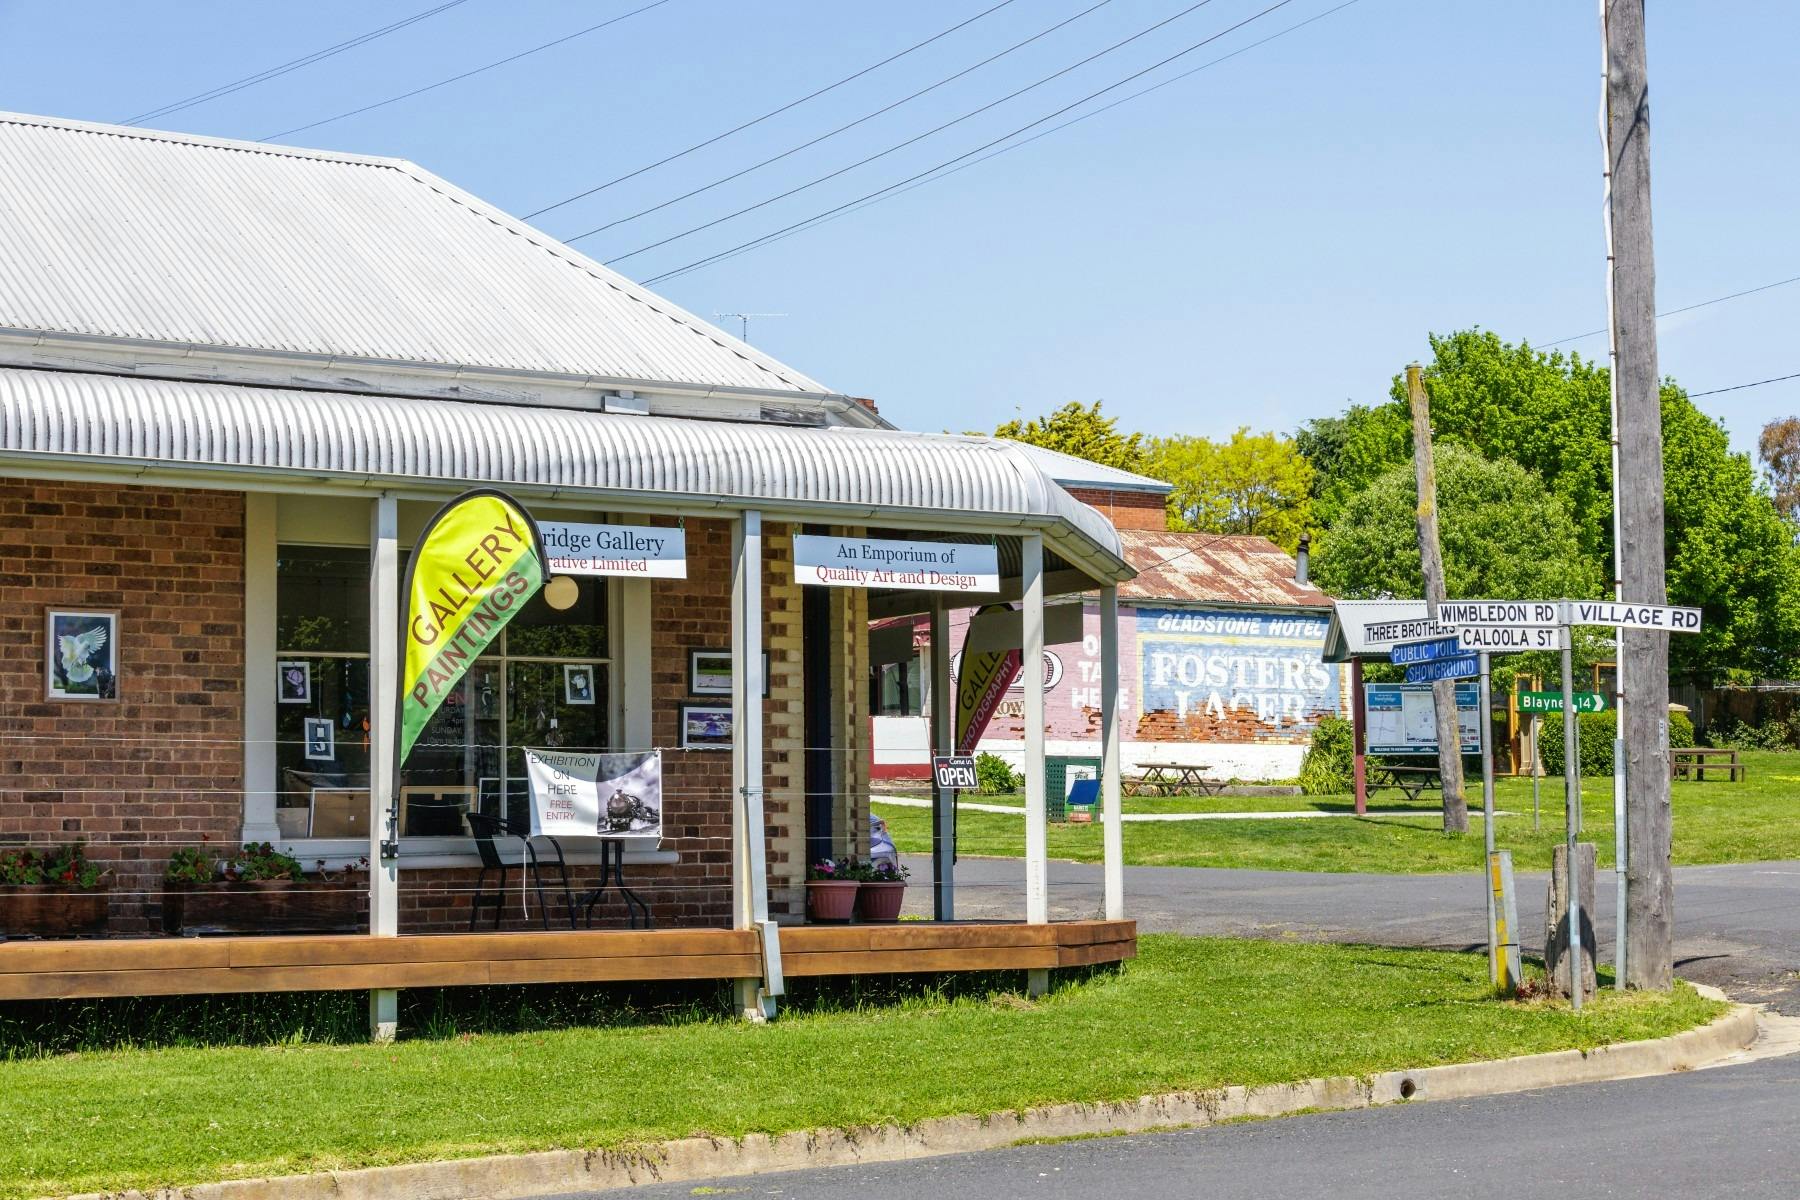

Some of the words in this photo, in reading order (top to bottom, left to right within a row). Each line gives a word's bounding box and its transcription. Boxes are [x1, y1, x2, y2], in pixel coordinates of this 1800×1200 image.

[541, 528, 591, 553] ridge
[597, 531, 664, 556] Gallery
[547, 554, 588, 569] rative
[592, 556, 648, 572] Limited
[837, 543, 857, 559] An
[862, 544, 937, 564] Emporium
[941, 548, 956, 564] of
[411, 512, 522, 645] GALLERY
[816, 565, 868, 585] Quality
[872, 569, 895, 583] Art
[899, 569, 925, 584] and
[929, 571, 977, 590] Design
[1440, 605, 1527, 622] WIMBLEDON
[1535, 605, 1554, 622] RD
[1579, 604, 1663, 626] VILLAGE
[1672, 611, 1699, 628] RD
[1157, 614, 1262, 634] GLADSTONE
[1268, 618, 1323, 637] HOTEL
[1366, 624, 1399, 642] THREE
[1401, 620, 1456, 638] BROTHERS
[412, 571, 528, 709] PAINTINGS
[1463, 629, 1529, 646] CALOOLA
[1537, 630, 1553, 646] ST
[1393, 643, 1429, 662] PUBLIC
[1434, 639, 1474, 658] TOILE
[962, 651, 1001, 711] GALLE
[1077, 661, 1121, 682] TA
[1150, 652, 1331, 691] FOSTER'S
[1408, 659, 1474, 682] SHOWGROUND
[447, 692, 466, 704] EN
[961, 655, 1014, 755] PHOTOGRAPHY
[1071, 687, 1129, 709] HEE
[1523, 696, 1564, 711] Blayne
[1578, 697, 1591, 709] 14
[531, 755, 596, 767] EXHIBITION
[553, 769, 570, 780] ON
[939, 767, 975, 786] OPEN
[547, 784, 577, 795] HERE
[550, 800, 573, 809] FREE
[546, 811, 575, 820] ENTRY
